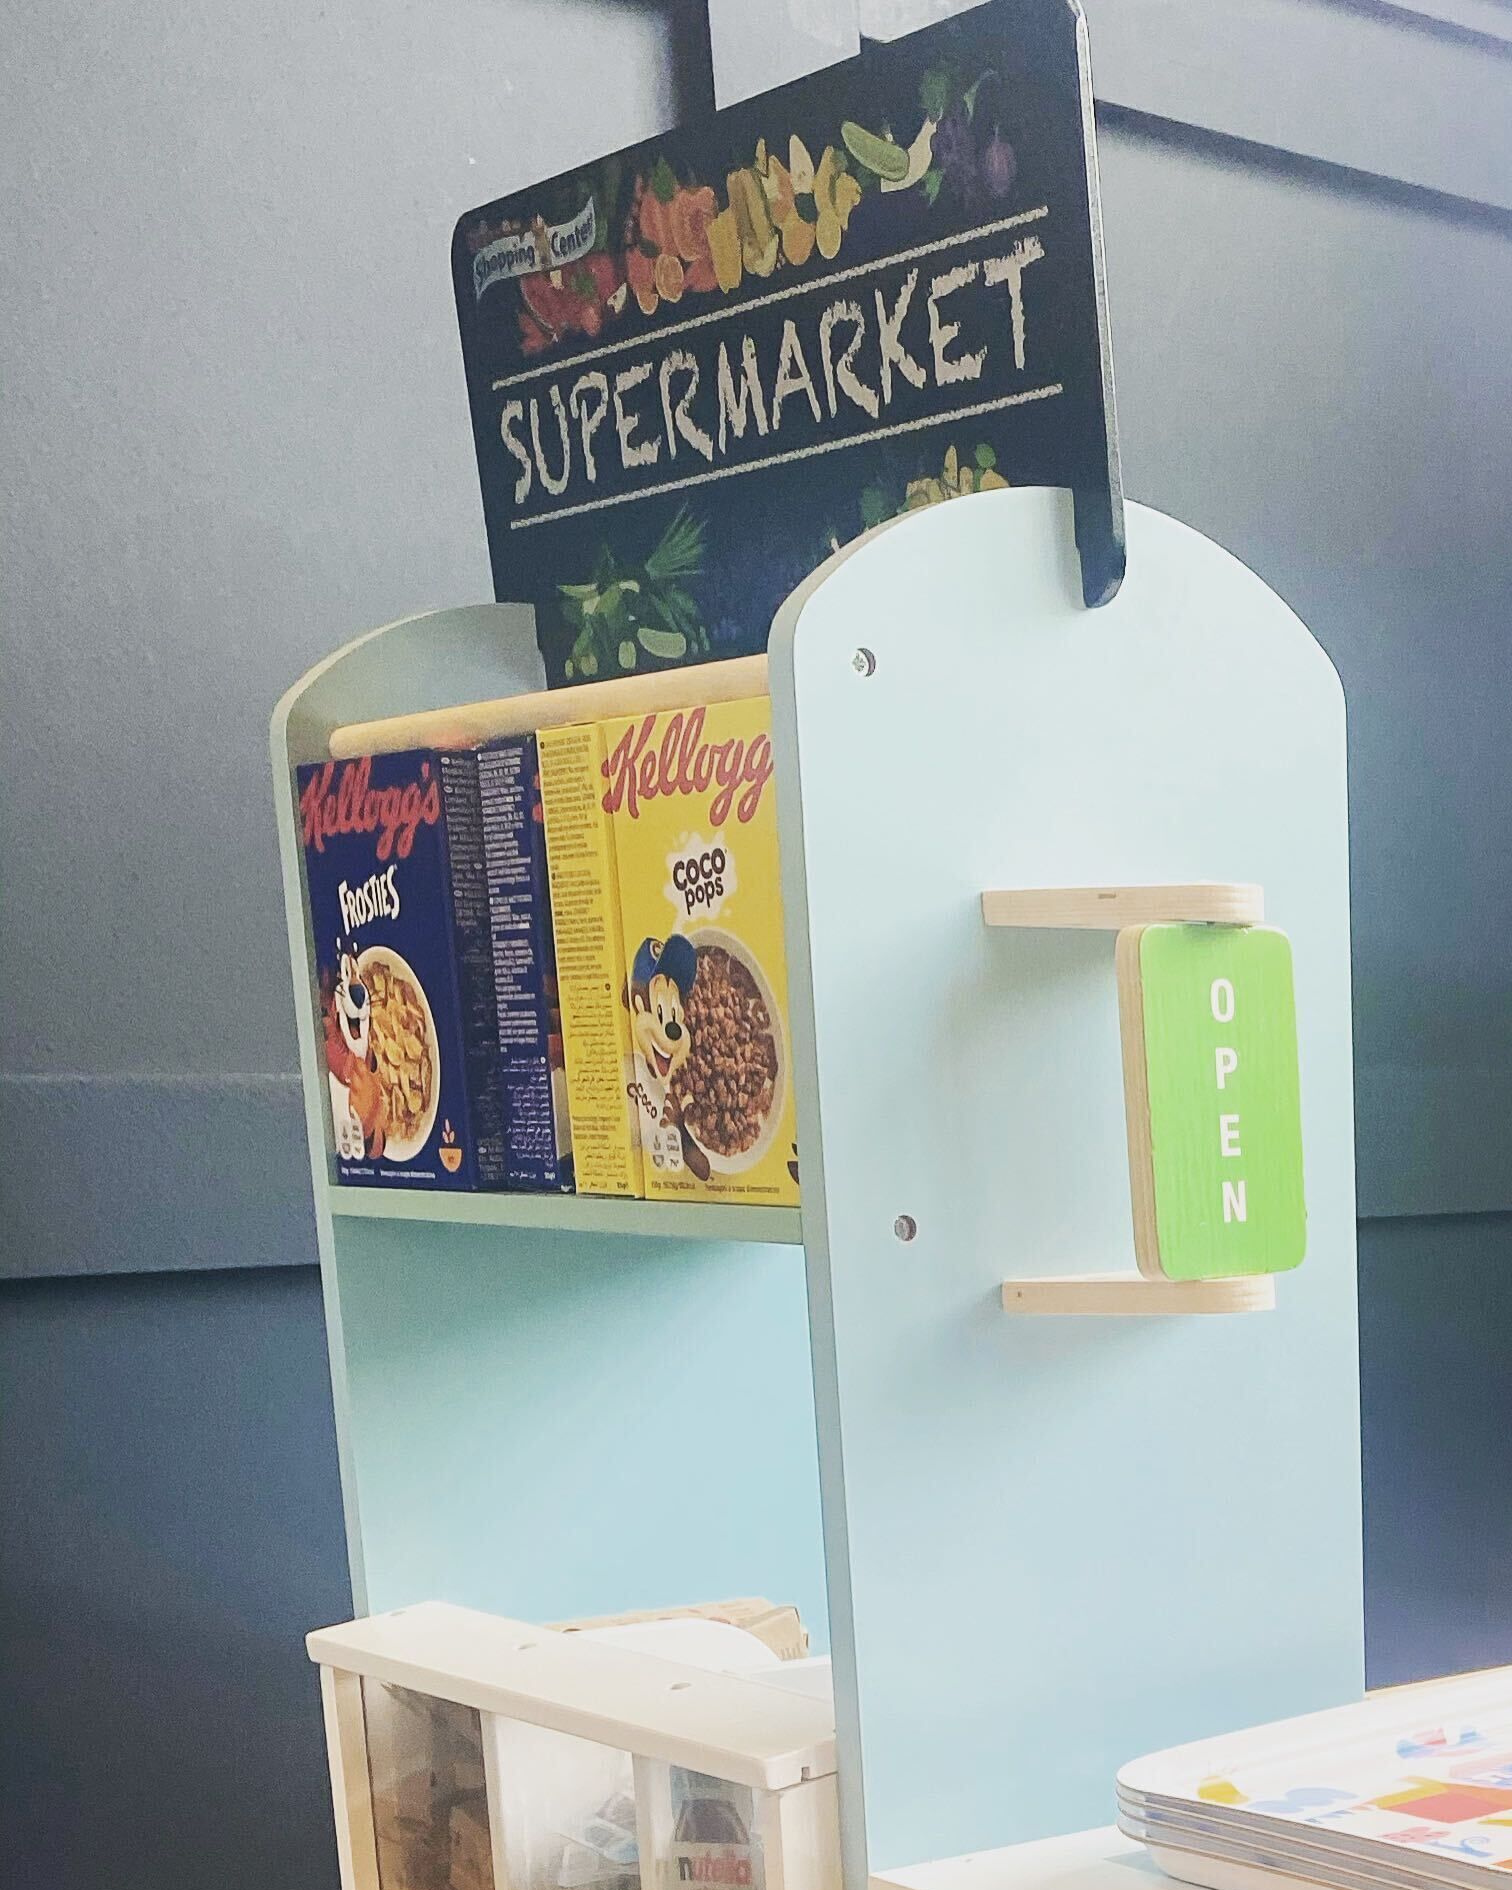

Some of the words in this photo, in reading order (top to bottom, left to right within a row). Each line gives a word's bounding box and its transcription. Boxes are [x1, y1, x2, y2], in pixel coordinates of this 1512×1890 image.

[500, 236, 1046, 504] SUPERMARKET
[300, 756, 441, 861] Kellogg's
[338, 864, 402, 937] FROSTIES
[683, 877, 724, 916] pops
[1210, 978, 1247, 1223] OPEN
